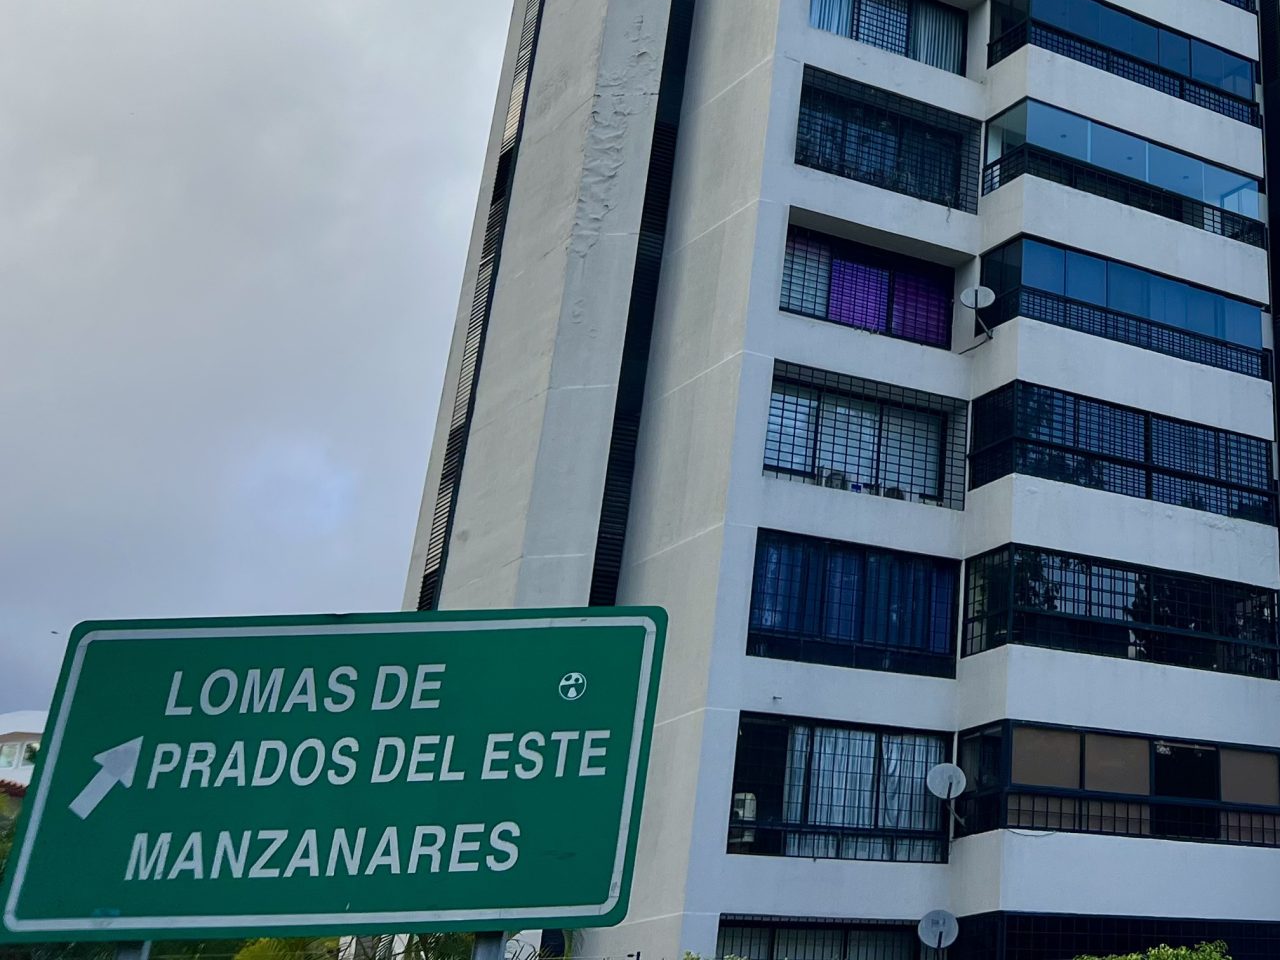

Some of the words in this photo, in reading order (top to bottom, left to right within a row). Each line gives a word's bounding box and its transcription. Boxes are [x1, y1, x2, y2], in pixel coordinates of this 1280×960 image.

[165, 666, 358, 716] LOMAS
[371, 664, 446, 711] DE
[147, 737, 359, 789] PRADOS
[371, 734, 465, 783] DEL
[480, 730, 610, 778] ESTE
[124, 822, 521, 881] MANZANARES
